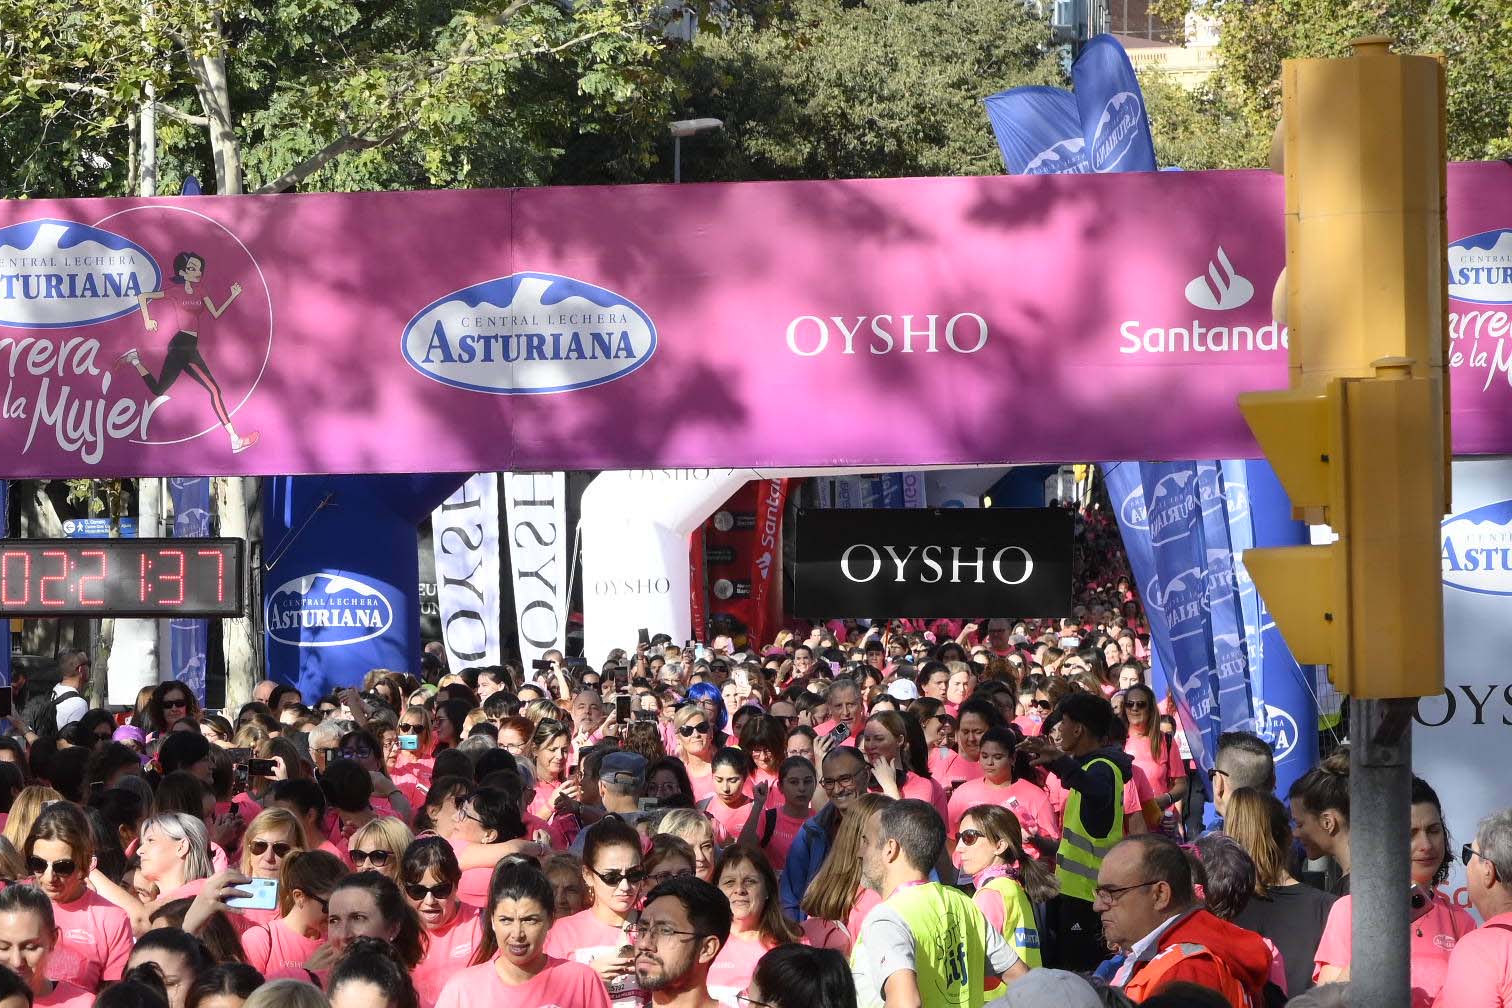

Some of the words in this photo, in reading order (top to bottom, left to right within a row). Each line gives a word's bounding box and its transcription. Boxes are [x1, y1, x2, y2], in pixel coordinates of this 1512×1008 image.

[63, 255, 136, 266] LECHERA
[462, 317, 540, 328] CENTRAL
[547, 313, 628, 325] LECHERA
[786, 313, 989, 355] OYSHO
[421, 319, 637, 364] ASTURIANA
[1119, 320, 1288, 353] Santande
[2, 382, 27, 419] la
[24, 372, 171, 465] Mujer
[1, 550, 224, 605] 02:21:37
[840, 544, 1034, 585] OYSHO
[595, 577, 671, 595] OYSHO
[271, 603, 383, 629] ASTURIANA
[283, 598, 325, 606] CENTRAL
[330, 598, 378, 606] LECHERA
[608, 984, 625, 992] 5792
